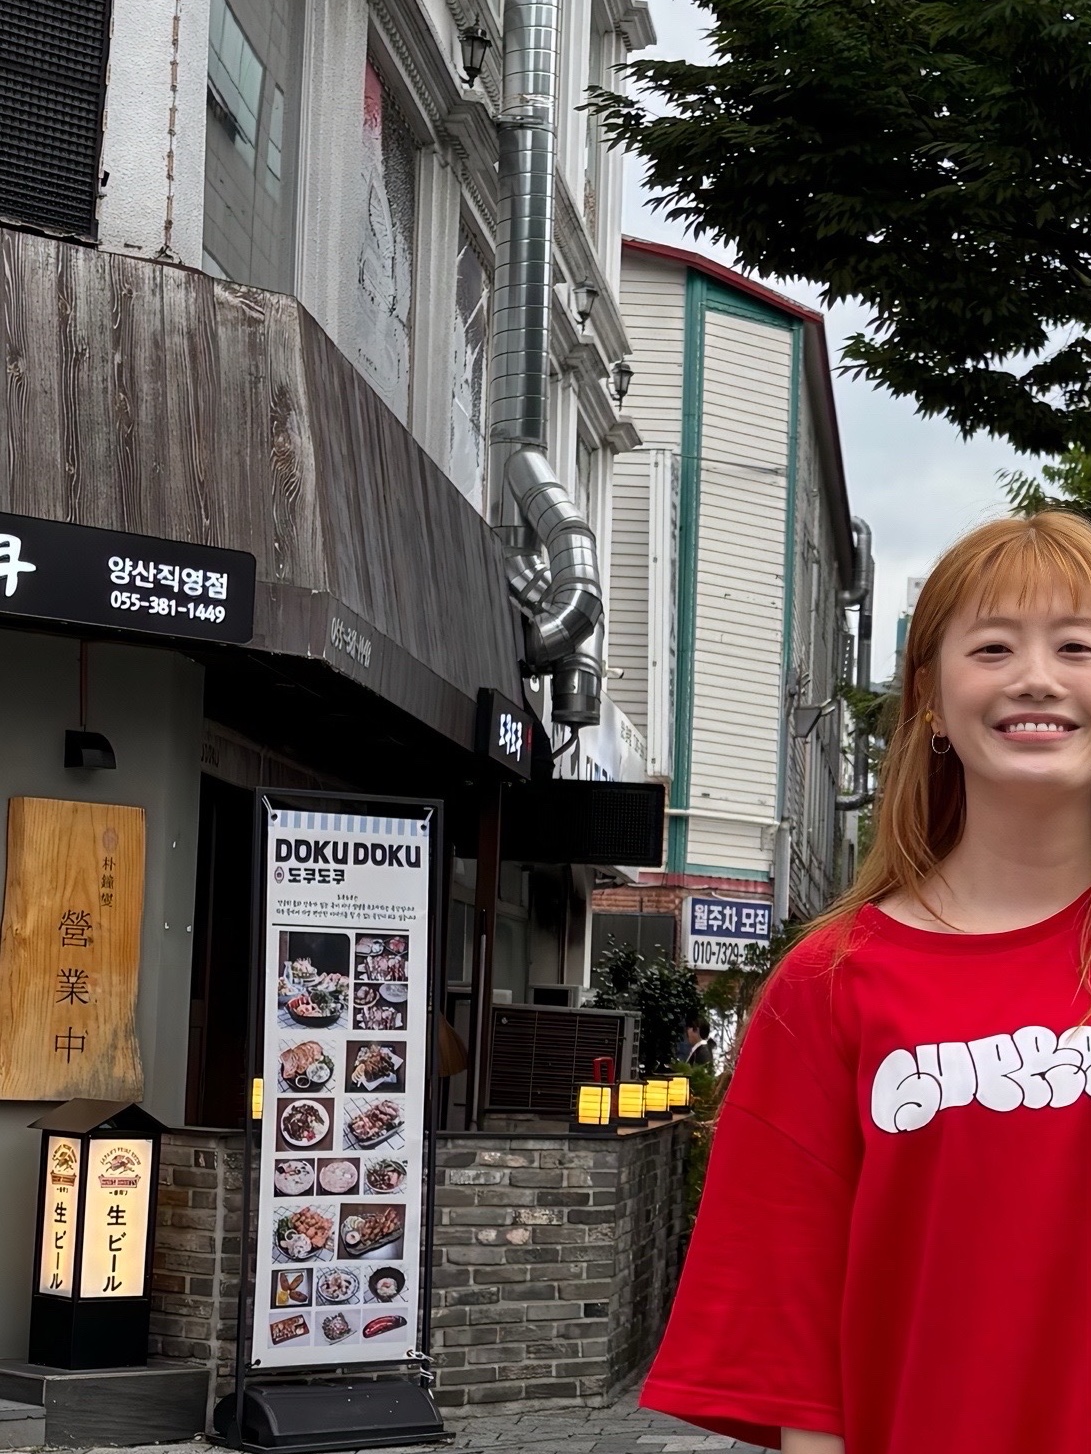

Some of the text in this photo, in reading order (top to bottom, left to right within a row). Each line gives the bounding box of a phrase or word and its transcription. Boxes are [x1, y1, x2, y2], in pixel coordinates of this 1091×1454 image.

[108, 556, 228, 600] 양산직영점
[110, 590, 226, 624] 055-381-1449
[275, 838, 421, 868] DOKU DOKU
[288, 867, 345, 884] 도쿠도쿠
[694, 904, 769, 935] 월주차 모집
[54, 908, 93, 1065] 營業中
[50, 1202, 67, 1290] 生ビール
[102, 1204, 127, 1293] 生ビール
